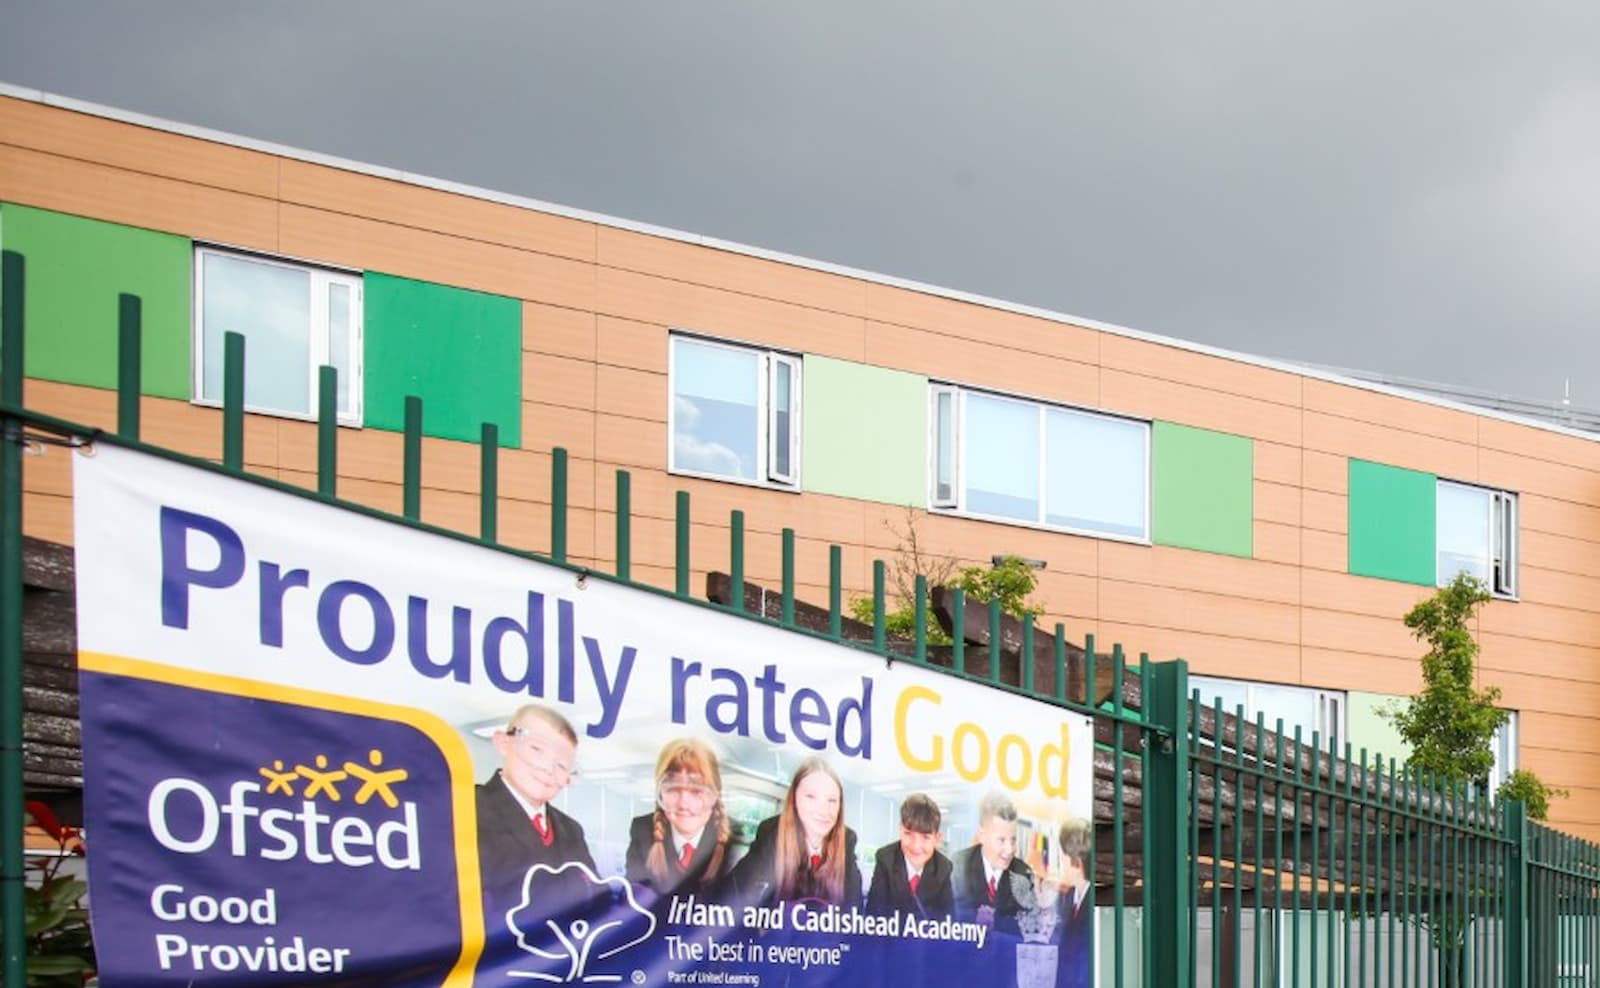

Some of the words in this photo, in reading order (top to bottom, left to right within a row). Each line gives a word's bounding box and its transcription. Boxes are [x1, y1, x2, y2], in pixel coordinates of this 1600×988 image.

[160, 505, 637, 738] Proudly
[670, 655, 873, 759] rated
[894, 685, 1071, 800] Good
[148, 778, 422, 871] Ofsted
[151, 884, 277, 925] Good
[667, 894, 735, 927] Irlam
[743, 901, 785, 930] and
[791, 904, 899, 937] Cadishead
[902, 913, 987, 949] Academy
[155, 934, 350, 973] Provider
[664, 936, 703, 962] The
[708, 936, 744, 963] best
[748, 938, 764, 963] in
[667, 971, 686, 984] Part
[687, 971, 698, 984] of
[698, 971, 724, 985] United
[725, 973, 760, 987] Learning
